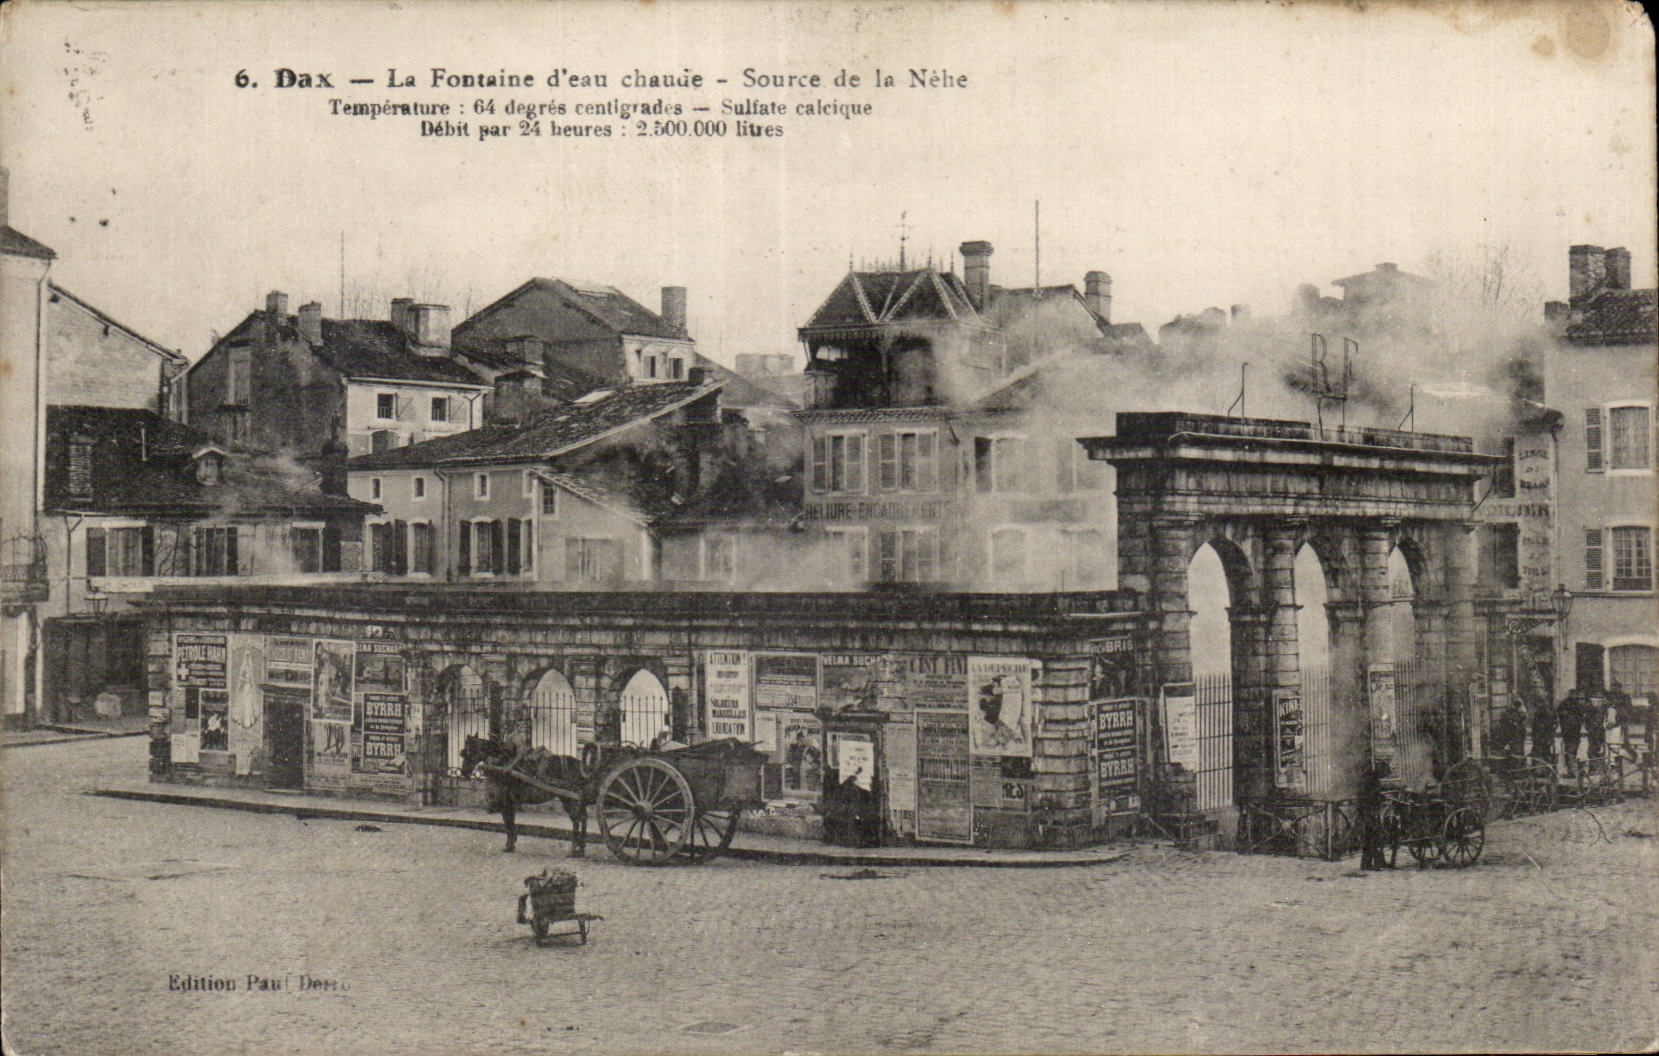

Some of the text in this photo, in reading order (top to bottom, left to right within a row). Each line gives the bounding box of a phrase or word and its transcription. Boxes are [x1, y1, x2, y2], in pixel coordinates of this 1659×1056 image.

[366, 702, 402, 717] BYRRH
[1099, 709, 1134, 730] BYRRH
[1100, 758, 1135, 778] BYRRH
